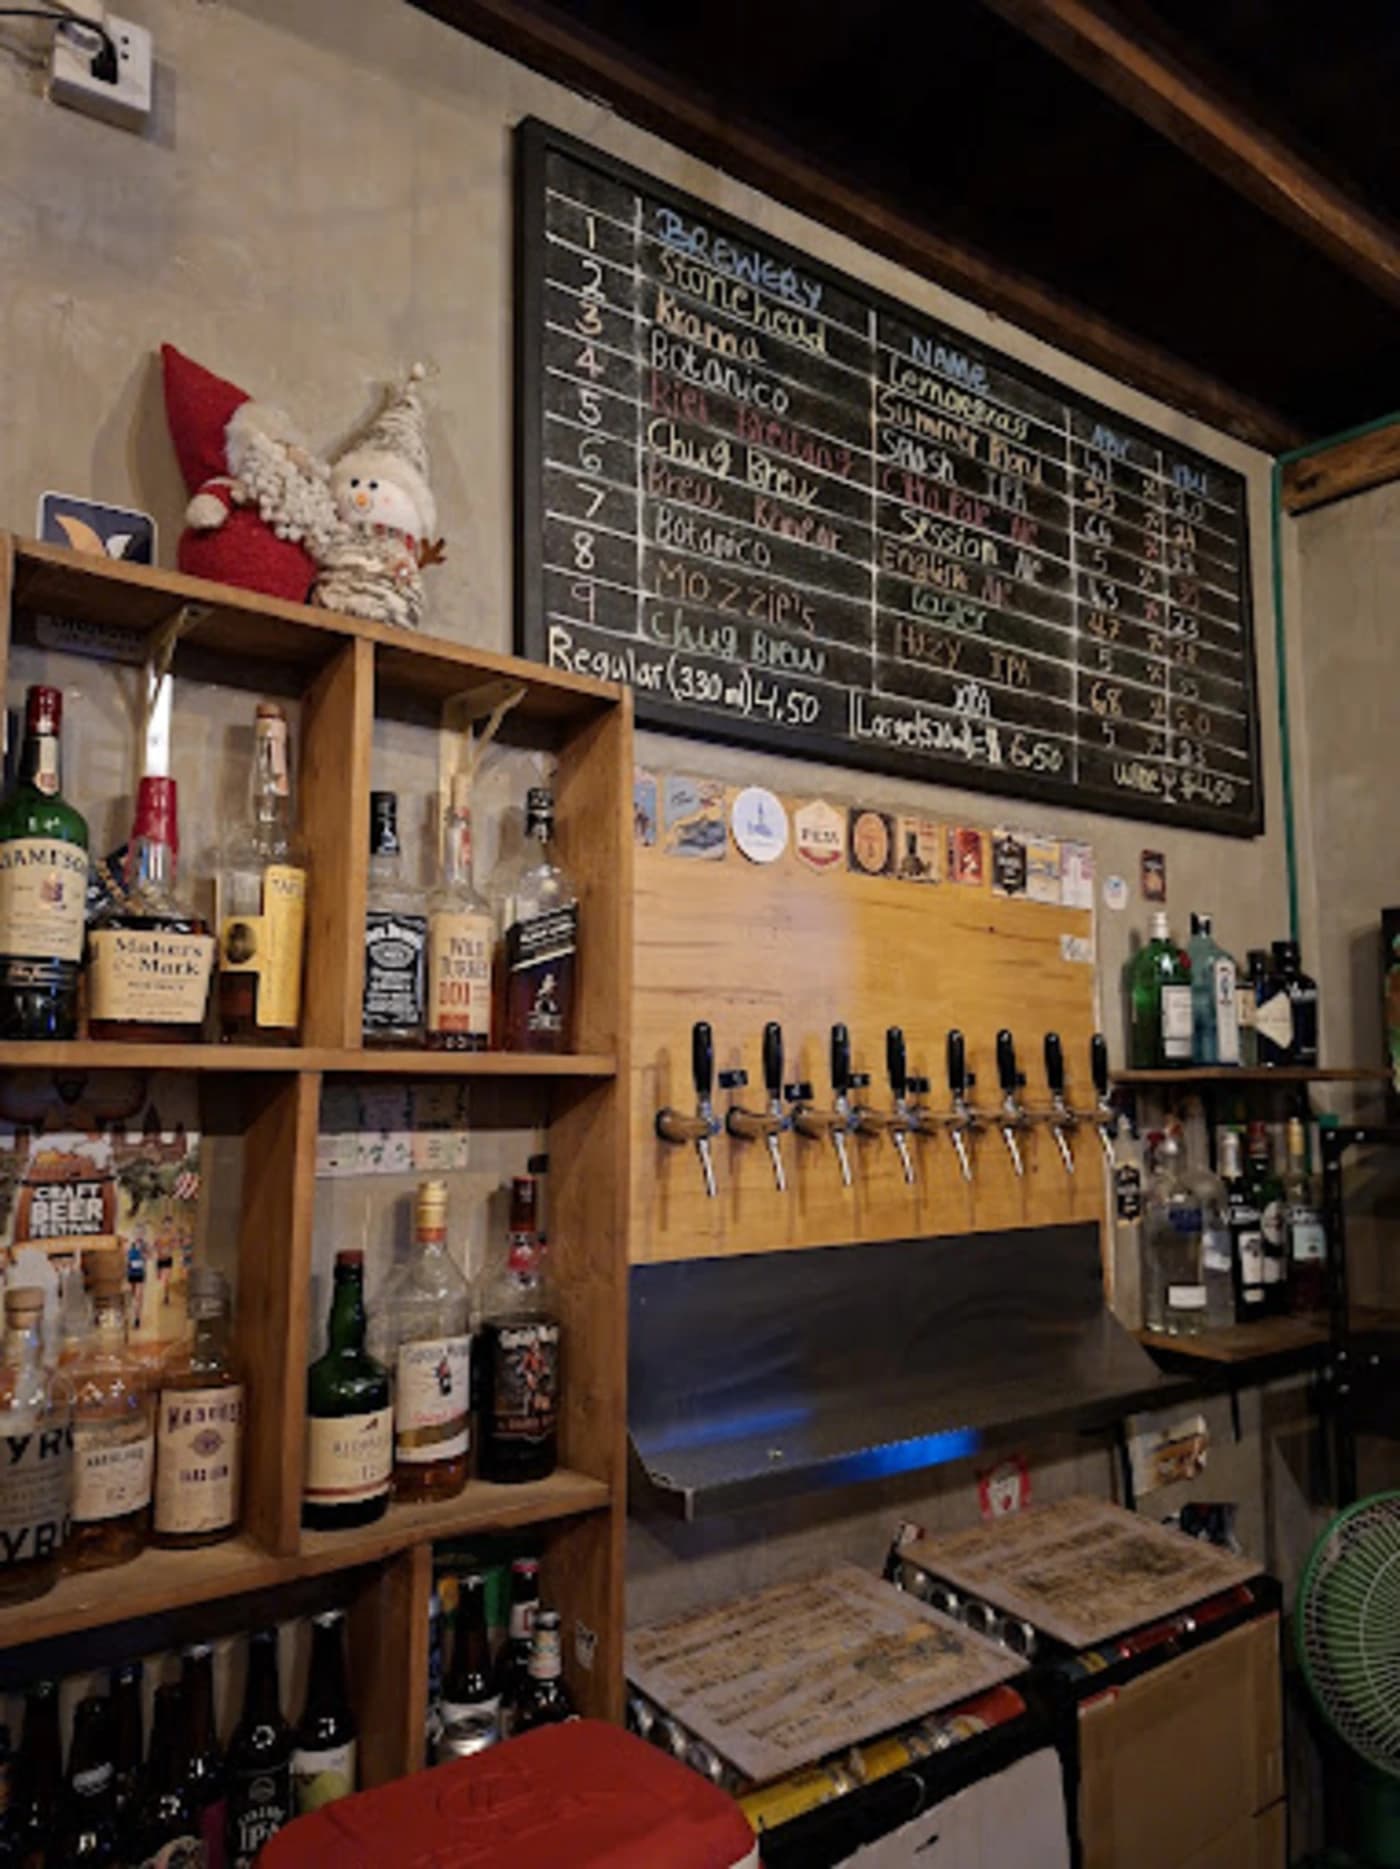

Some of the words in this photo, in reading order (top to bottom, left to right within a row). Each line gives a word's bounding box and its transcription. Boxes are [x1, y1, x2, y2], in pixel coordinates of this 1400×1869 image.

[585, 216, 596, 249] 1
[581, 259, 602, 295] 2
[655, 207, 823, 311] BREWERY
[575, 300, 603, 335] 3
[575, 347, 604, 378] 4
[651, 329, 789, 416] Botanico
[577, 389, 602, 426] 5
[577, 438, 605, 475] 6
[648, 416, 732, 480] Chug
[747, 449, 820, 506] Brew
[575, 482, 604, 518] 7
[573, 530, 595, 570] 8
[654, 502, 771, 567] Botanico
[650, 607, 739, 661] Chug
[549, 625, 663, 691] Regular
[31, 1199, 104, 1223] BEER
